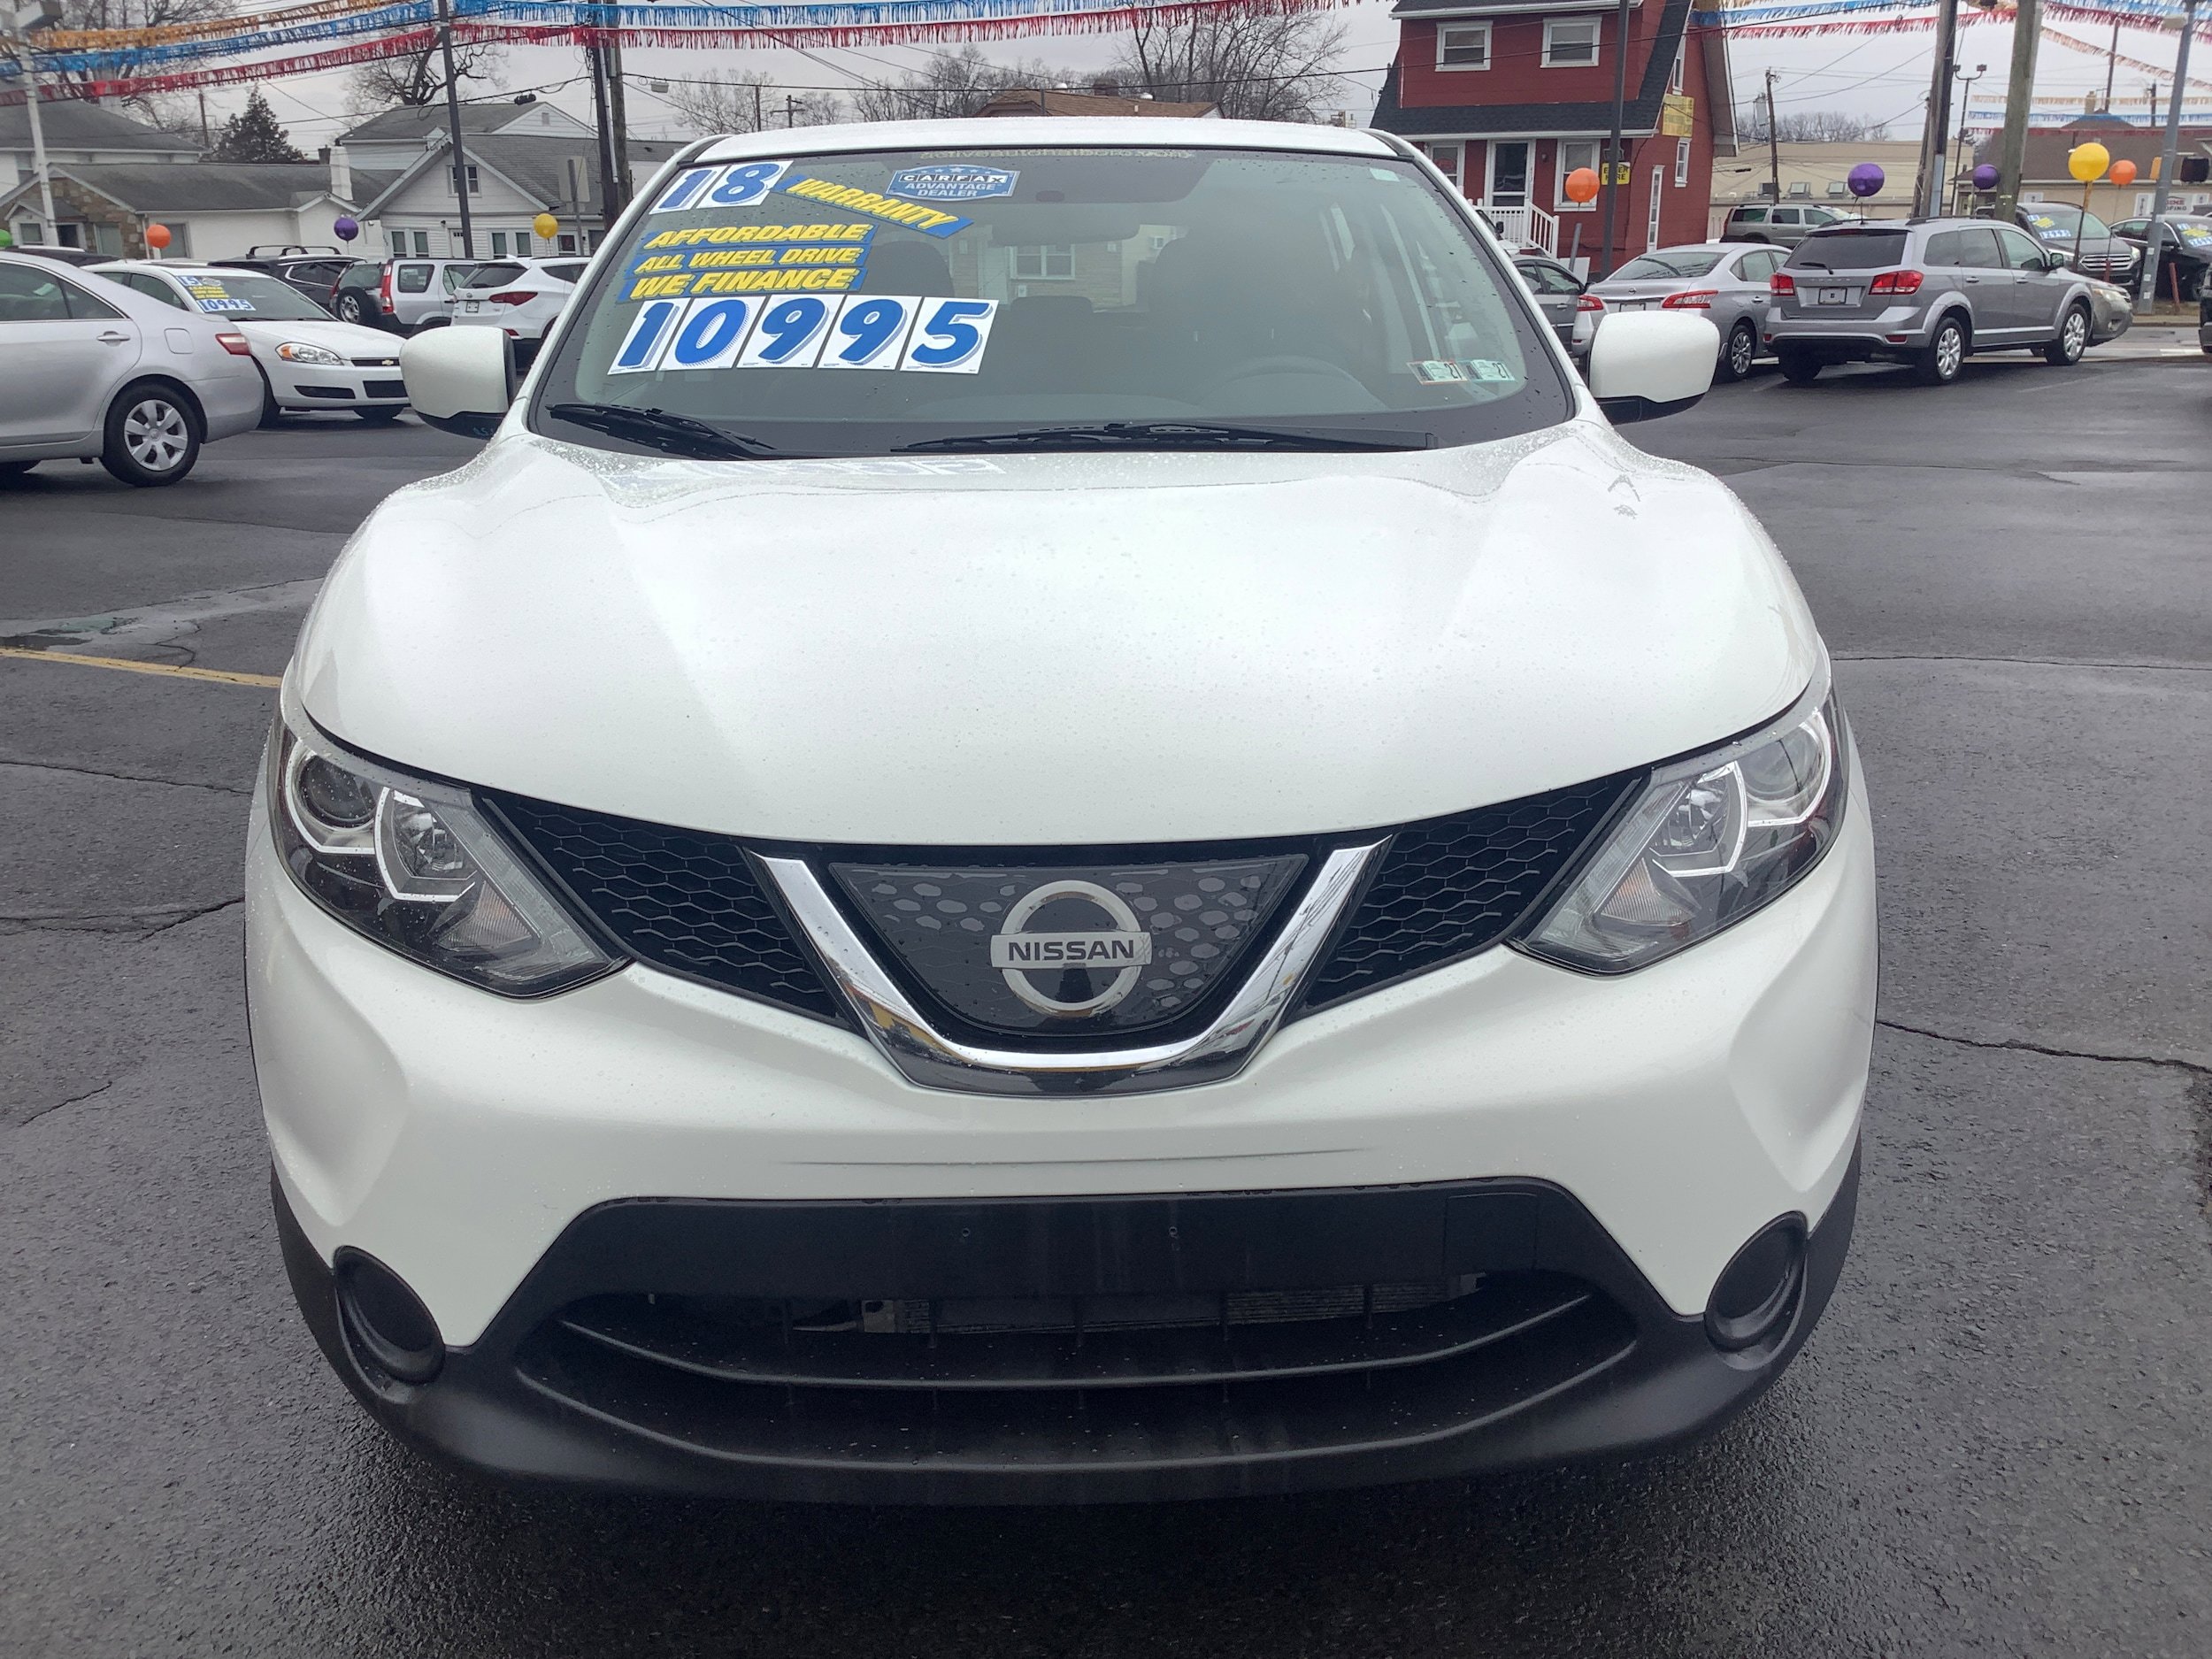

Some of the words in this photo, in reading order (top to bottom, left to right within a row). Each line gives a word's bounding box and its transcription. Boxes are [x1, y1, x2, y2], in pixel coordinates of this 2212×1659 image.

[657, 163, 784, 209] 18
[900, 174, 1007, 183] CARFAX
[904, 182, 996, 191] ADVANTAGE
[786, 178, 959, 230] WARRANTY
[643, 224, 874, 249] AFFORDABLE
[634, 254, 685, 274] ALL
[688, 249, 776, 268] WHEEL
[779, 248, 864, 265] DRIVE
[630, 273, 695, 300] WE
[690, 268, 859, 294] FINANCE
[197, 299, 253, 311] 10995
[617, 298, 995, 369] 10995
[1008, 940, 1135, 963] NISSAN
